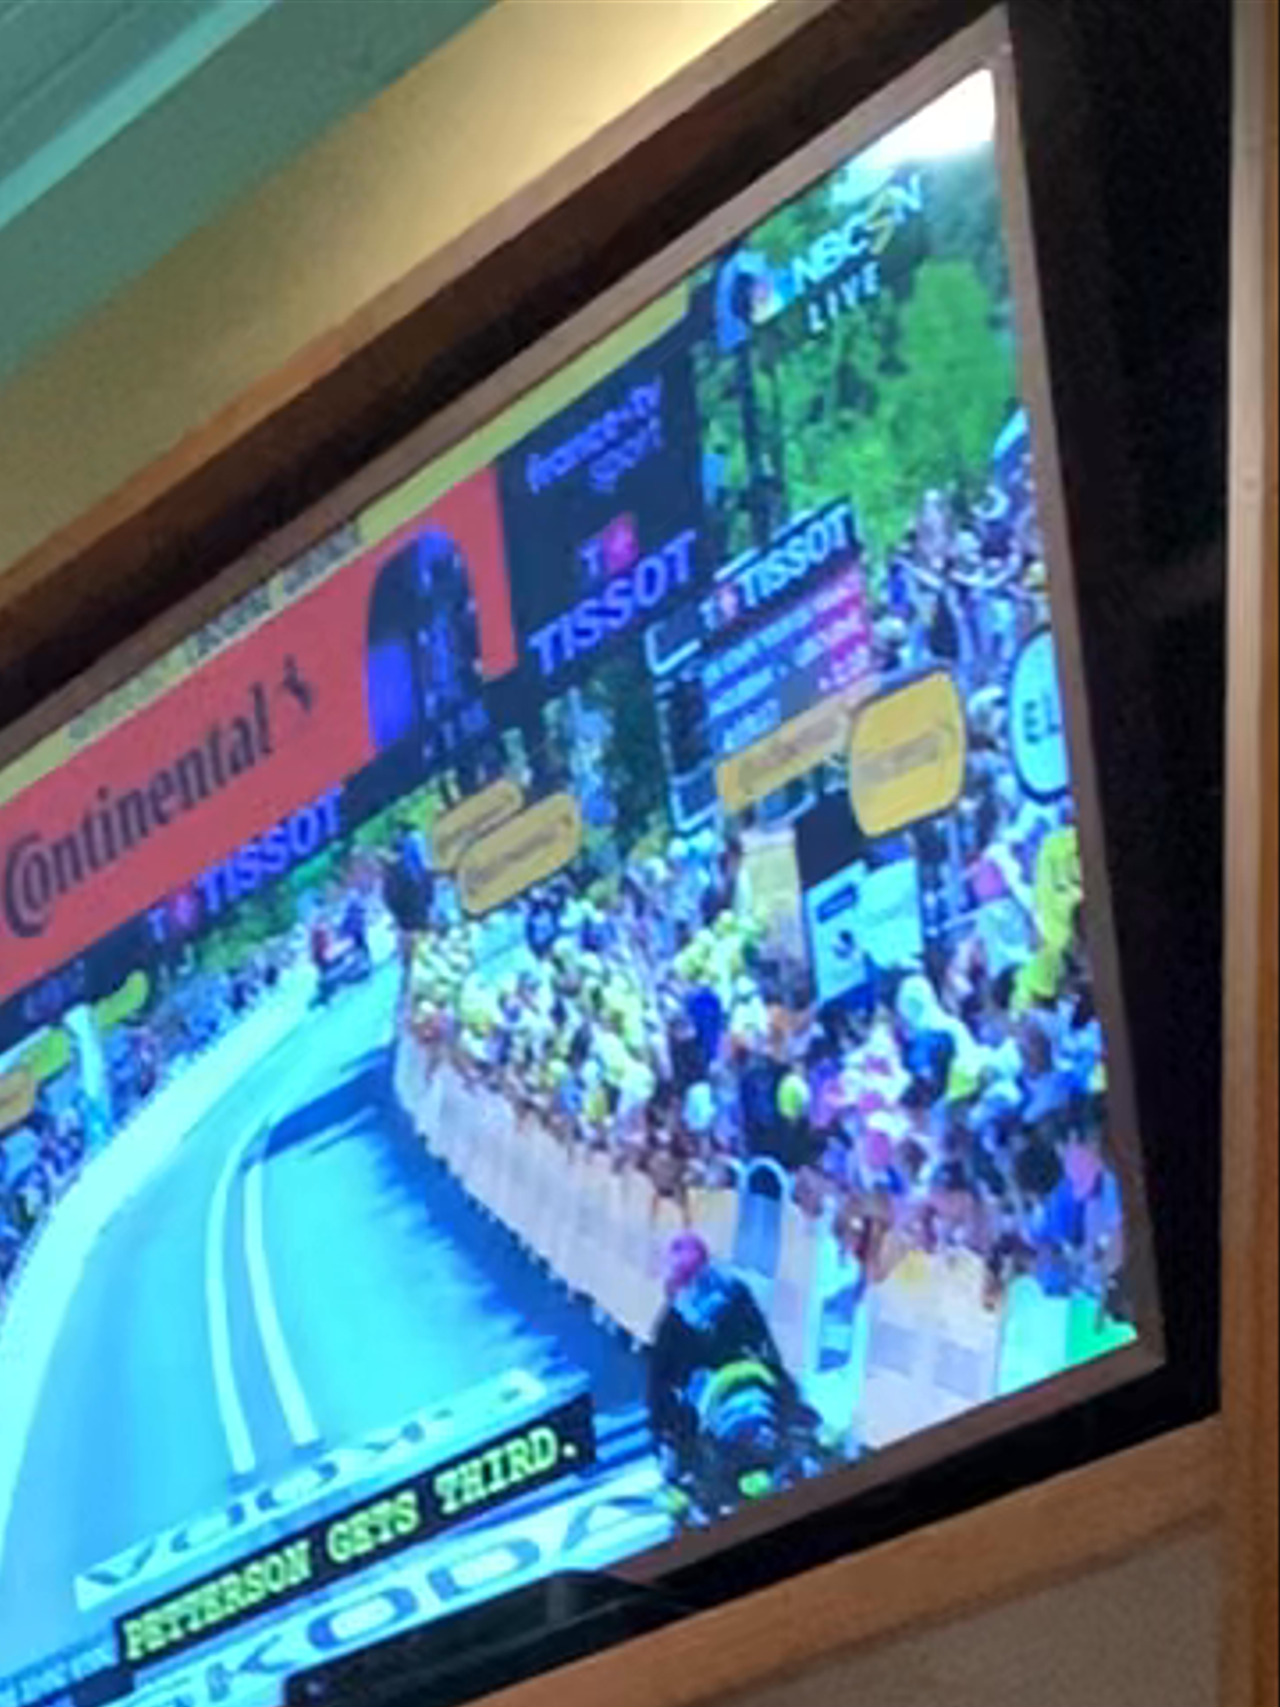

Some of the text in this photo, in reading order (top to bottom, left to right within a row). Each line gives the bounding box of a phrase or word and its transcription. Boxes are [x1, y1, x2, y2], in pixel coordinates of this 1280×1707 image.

[791, 172, 923, 296] NBCSN
[807, 261, 881, 334] LIVE
[528, 529, 696, 675] TISSOT
[736, 504, 848, 608] TISSOT
[1, 681, 274, 938] Continental
[197, 784, 342, 912] TISSOT
[325, 1488, 421, 1563] GETS
[434, 1427, 578, 1513] THIRD.
